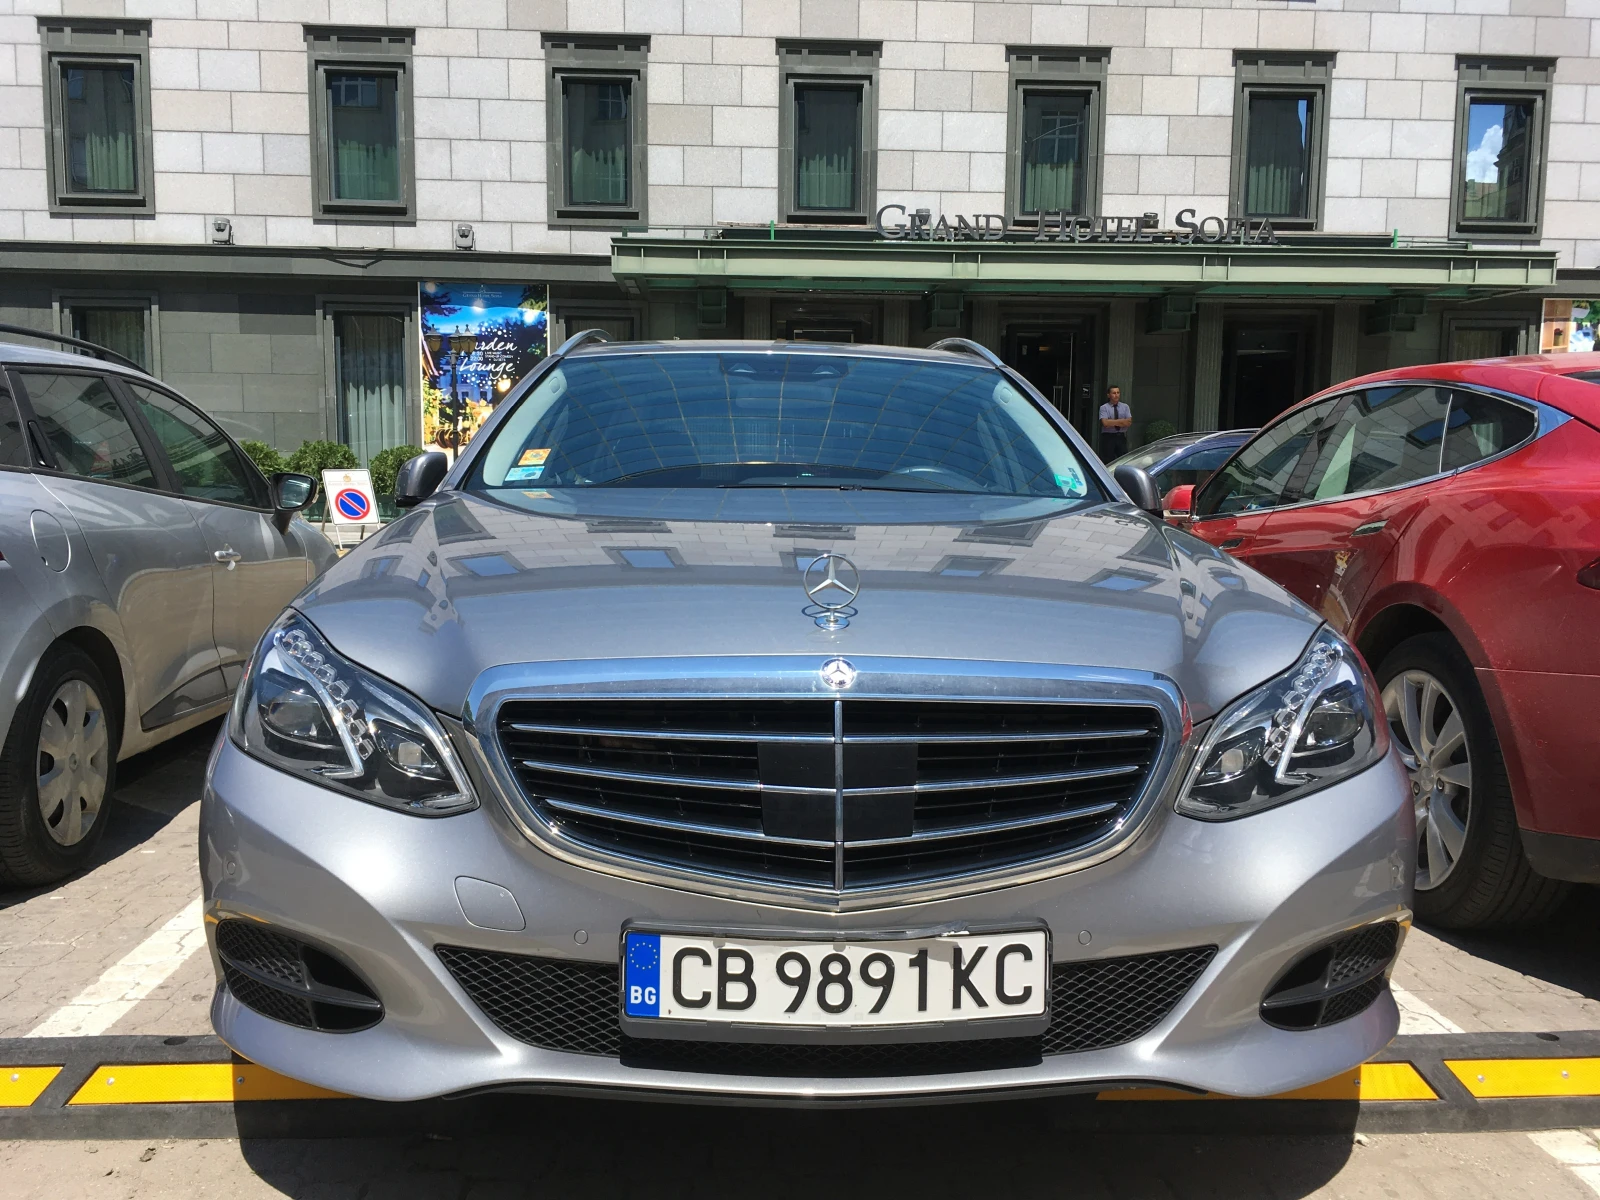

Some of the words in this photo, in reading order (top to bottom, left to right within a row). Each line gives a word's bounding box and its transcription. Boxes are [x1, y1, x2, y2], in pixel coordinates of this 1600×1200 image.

[875, 204, 1008, 240] GRAND
[1034, 208, 1153, 242] HOTEL
[1175, 208, 1279, 243] SOFIA
[459, 357, 516, 380] Lounge
[630, 986, 657, 1005] BG
[775, 948, 929, 1014] 9891
